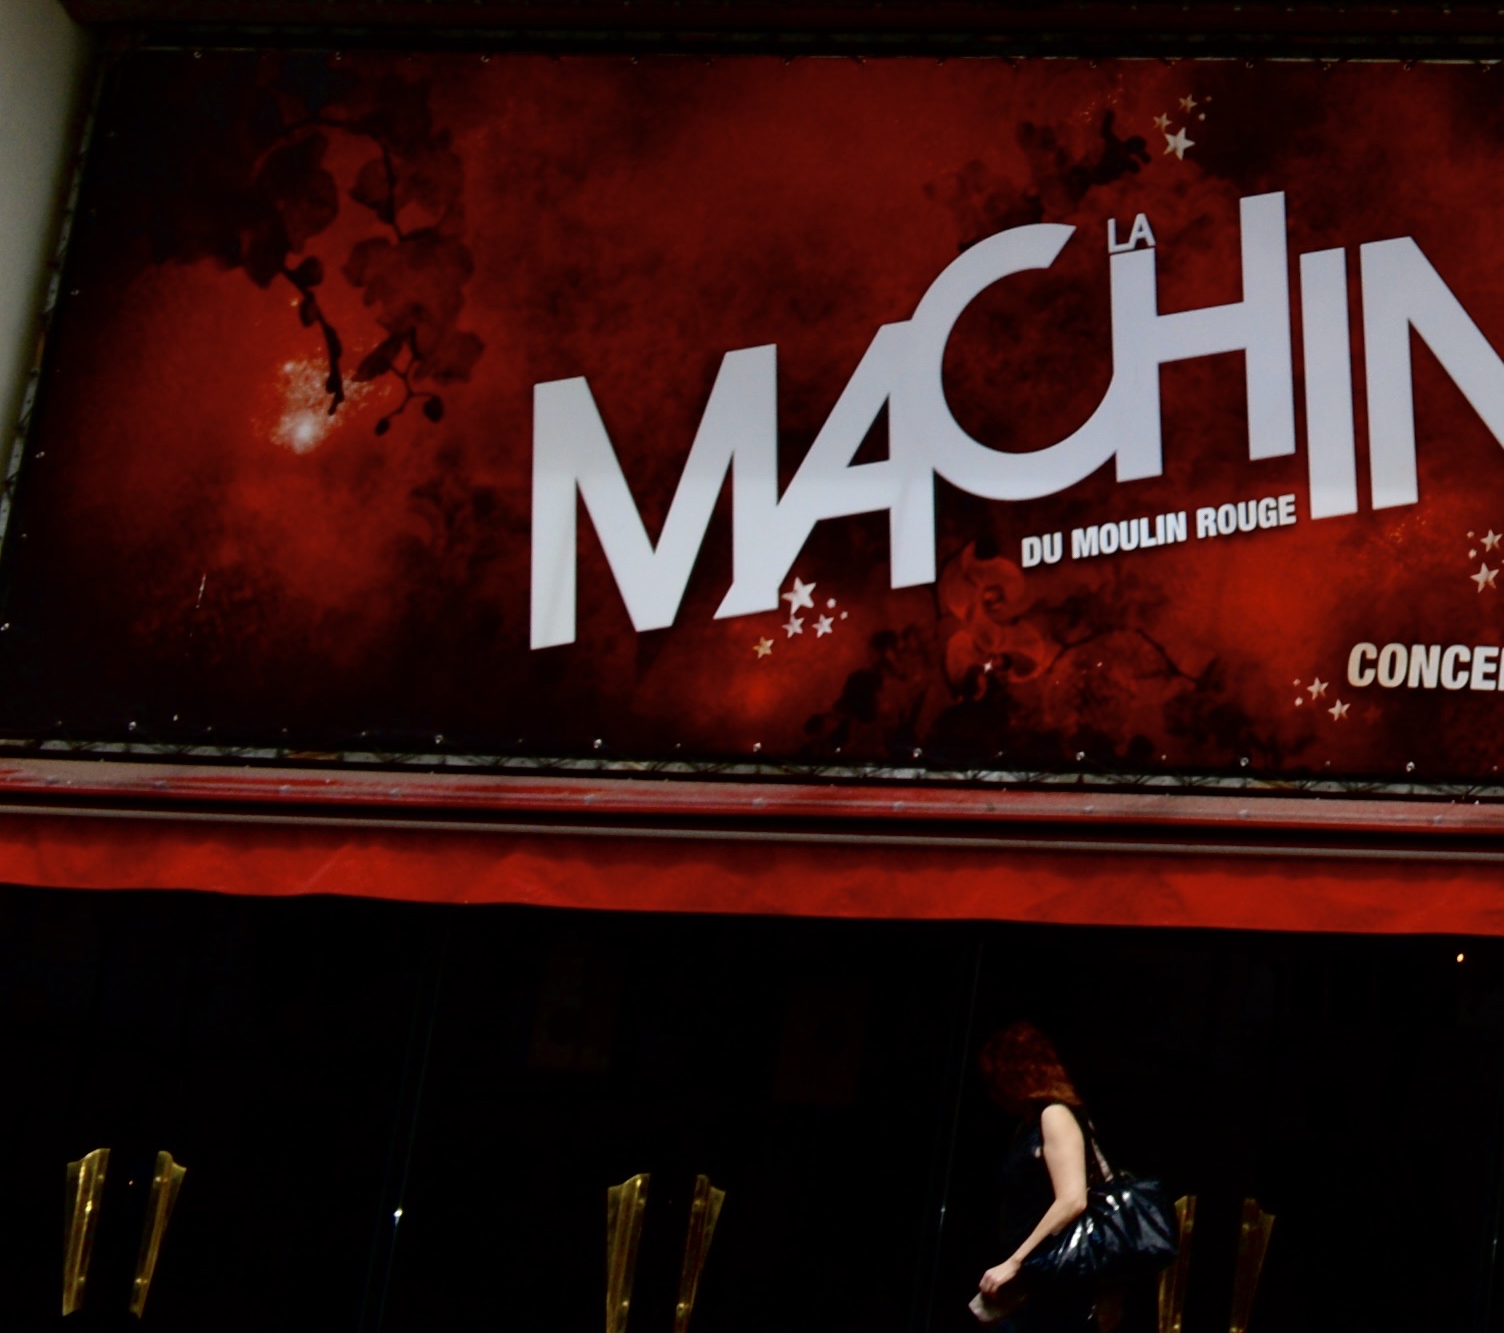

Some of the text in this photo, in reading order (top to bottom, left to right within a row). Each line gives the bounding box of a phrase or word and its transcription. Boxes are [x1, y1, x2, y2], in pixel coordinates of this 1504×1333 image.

[1107, 212, 1156, 254] LA
[1021, 493, 1297, 568] DU MOULIN ROUGE
